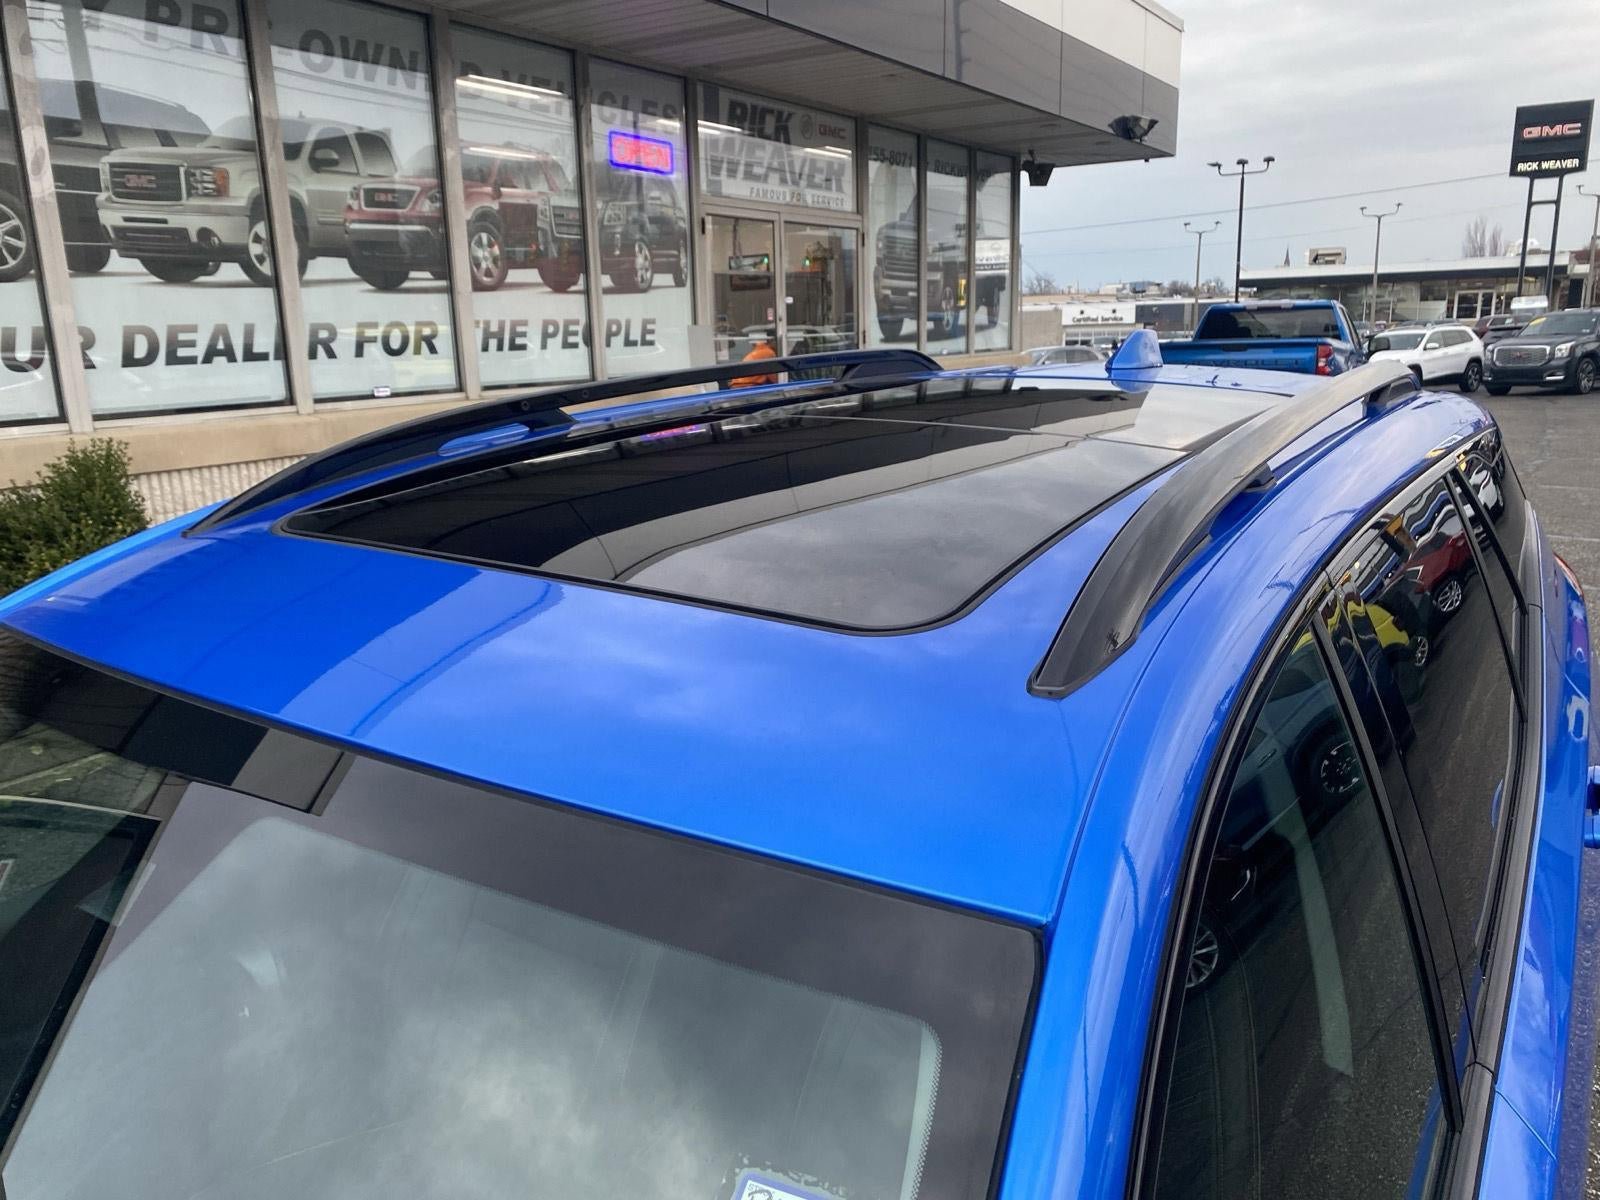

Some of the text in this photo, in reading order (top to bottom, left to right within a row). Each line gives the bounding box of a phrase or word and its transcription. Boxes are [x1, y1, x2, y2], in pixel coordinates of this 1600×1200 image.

[727, 100, 793, 145] RICK
[1523, 122, 1582, 139] GMC
[705, 135, 847, 193] WEAVER
[1517, 158, 1580, 172] RICK WEAVER
[750, 186, 787, 201] FAMOUS
[354, 320, 439, 358] FOR
